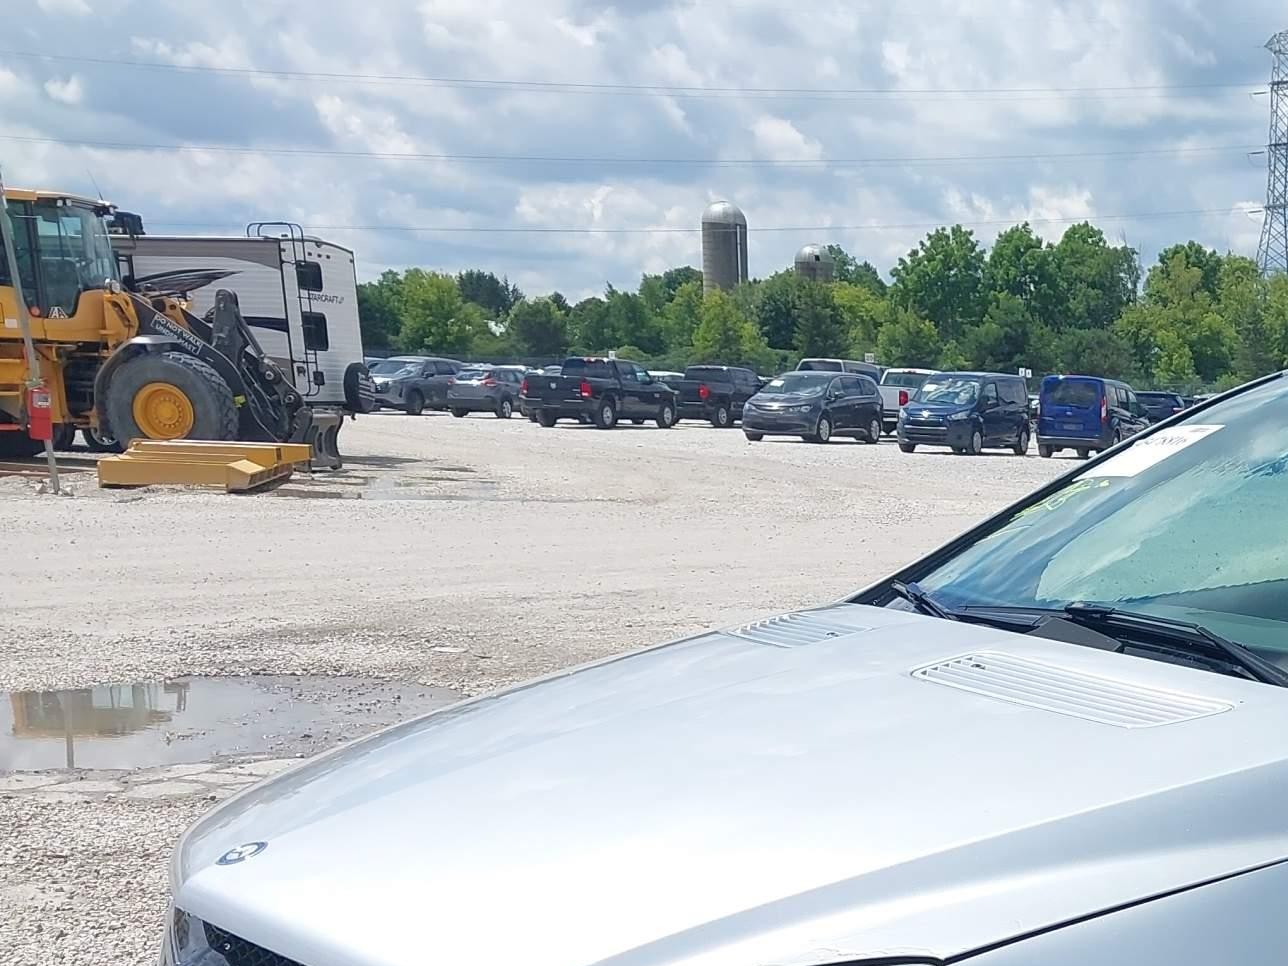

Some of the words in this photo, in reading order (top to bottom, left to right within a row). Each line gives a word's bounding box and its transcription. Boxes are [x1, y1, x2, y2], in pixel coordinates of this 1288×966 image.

[309, 293, 338, 304] TARCRAFT
[155, 314, 166, 325] DO
[166, 322, 181, 334] NOT
[182, 331, 202, 347] WALK
